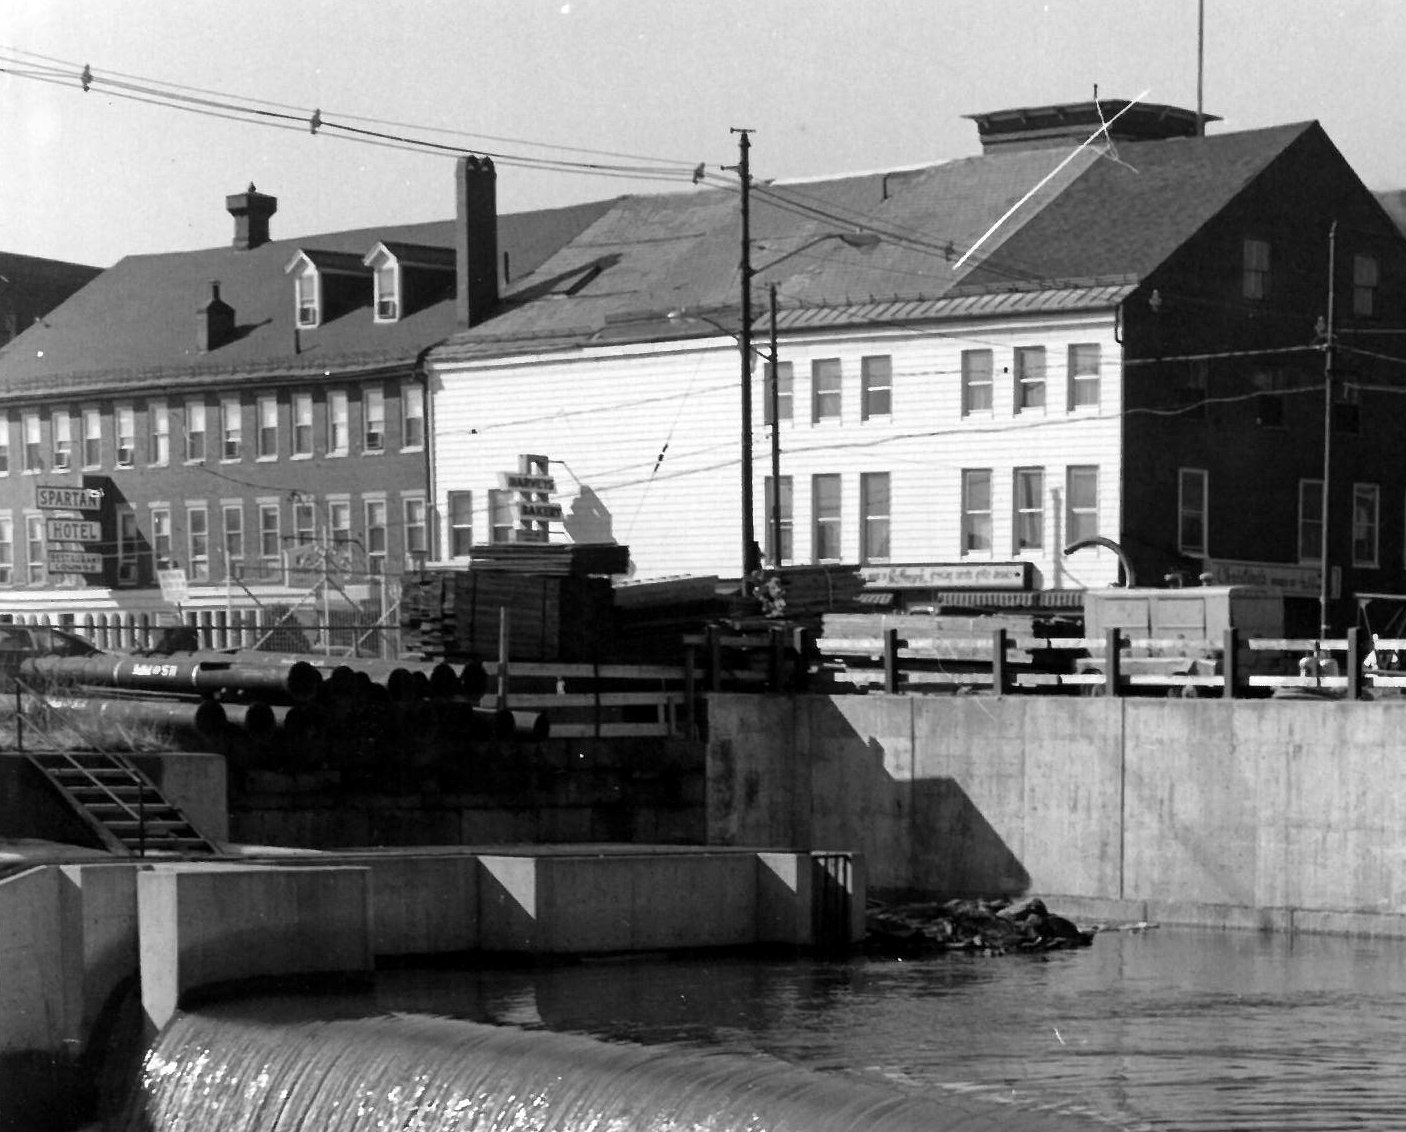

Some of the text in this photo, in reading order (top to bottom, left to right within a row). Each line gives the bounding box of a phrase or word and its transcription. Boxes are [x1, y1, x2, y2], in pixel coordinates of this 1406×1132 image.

[40, 490, 97, 507] SPARTAN
[522, 504, 562, 518] BAKERY
[53, 523, 97, 539] HOTEL
